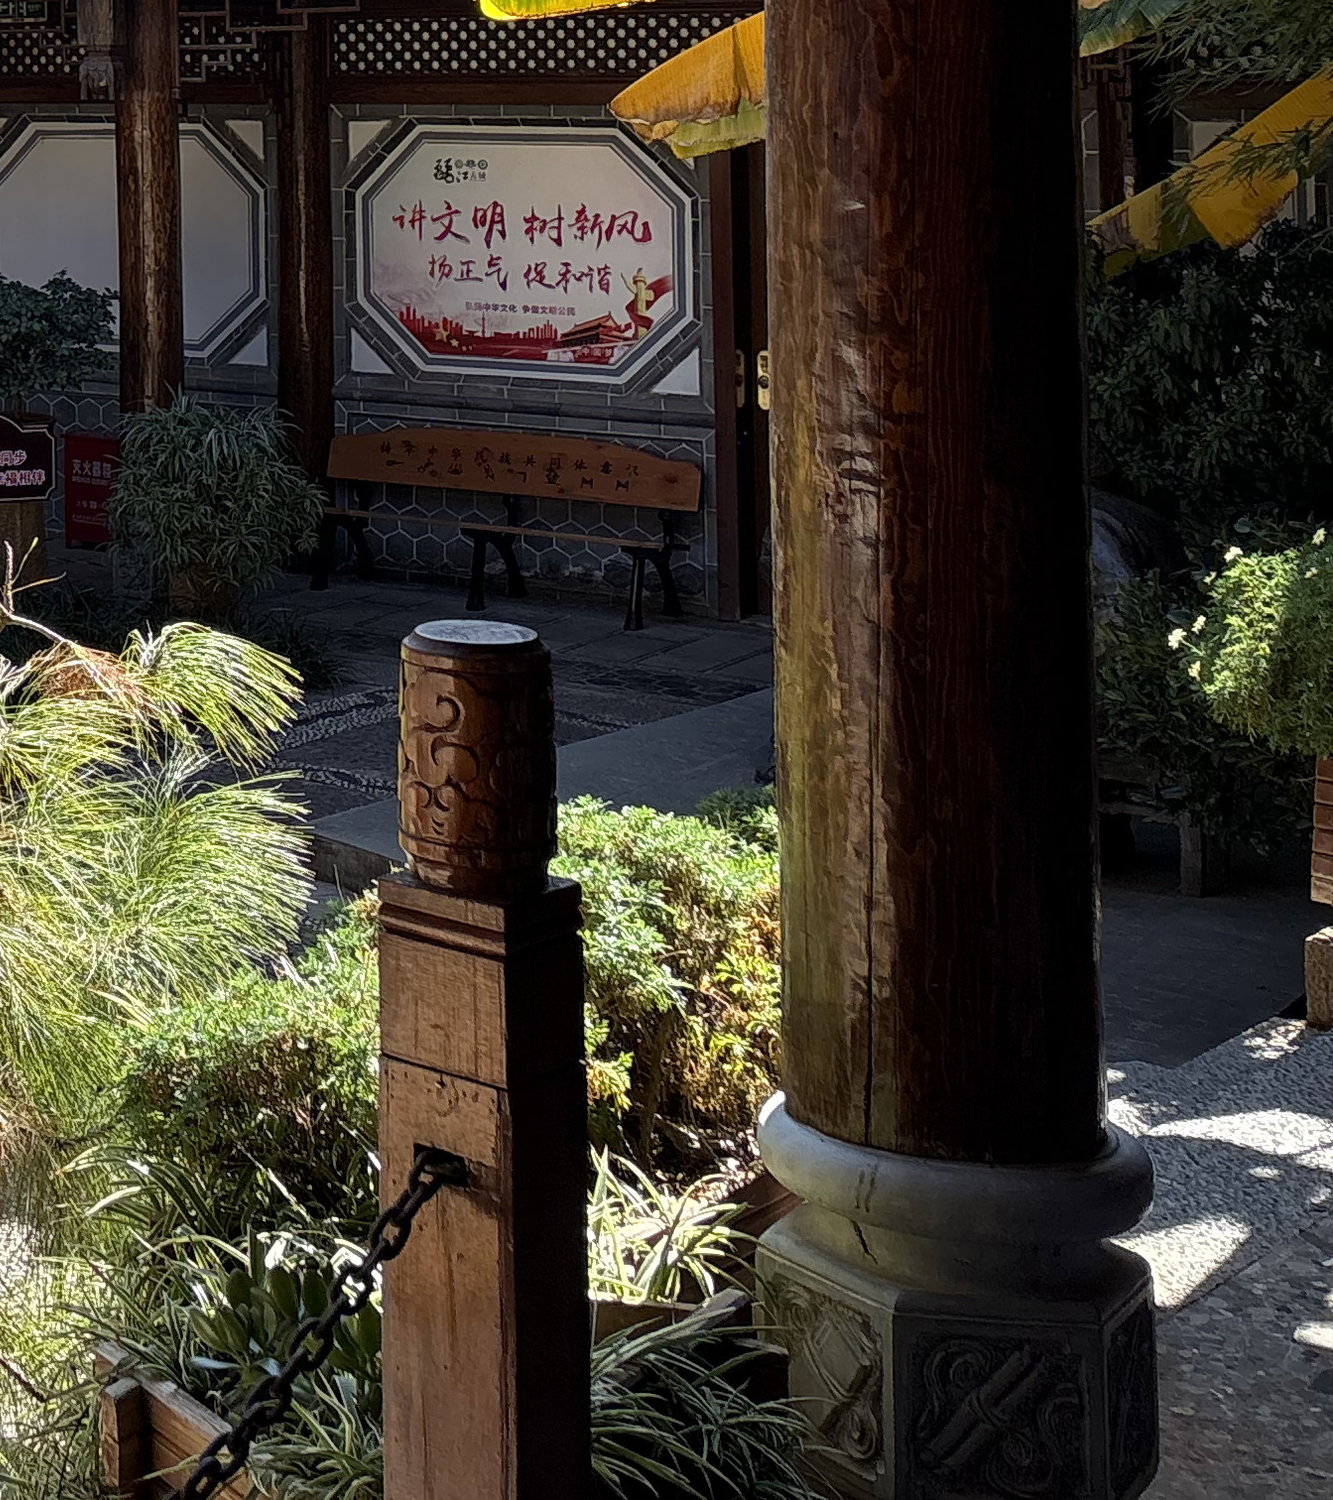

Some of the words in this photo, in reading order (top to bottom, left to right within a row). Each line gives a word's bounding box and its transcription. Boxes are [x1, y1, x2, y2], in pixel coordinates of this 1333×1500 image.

[392, 199, 507, 249] 讲文明
[523, 203, 652, 250] 树新风
[428, 254, 510, 292] 扬正气
[523, 261, 613, 295] 促和谐
